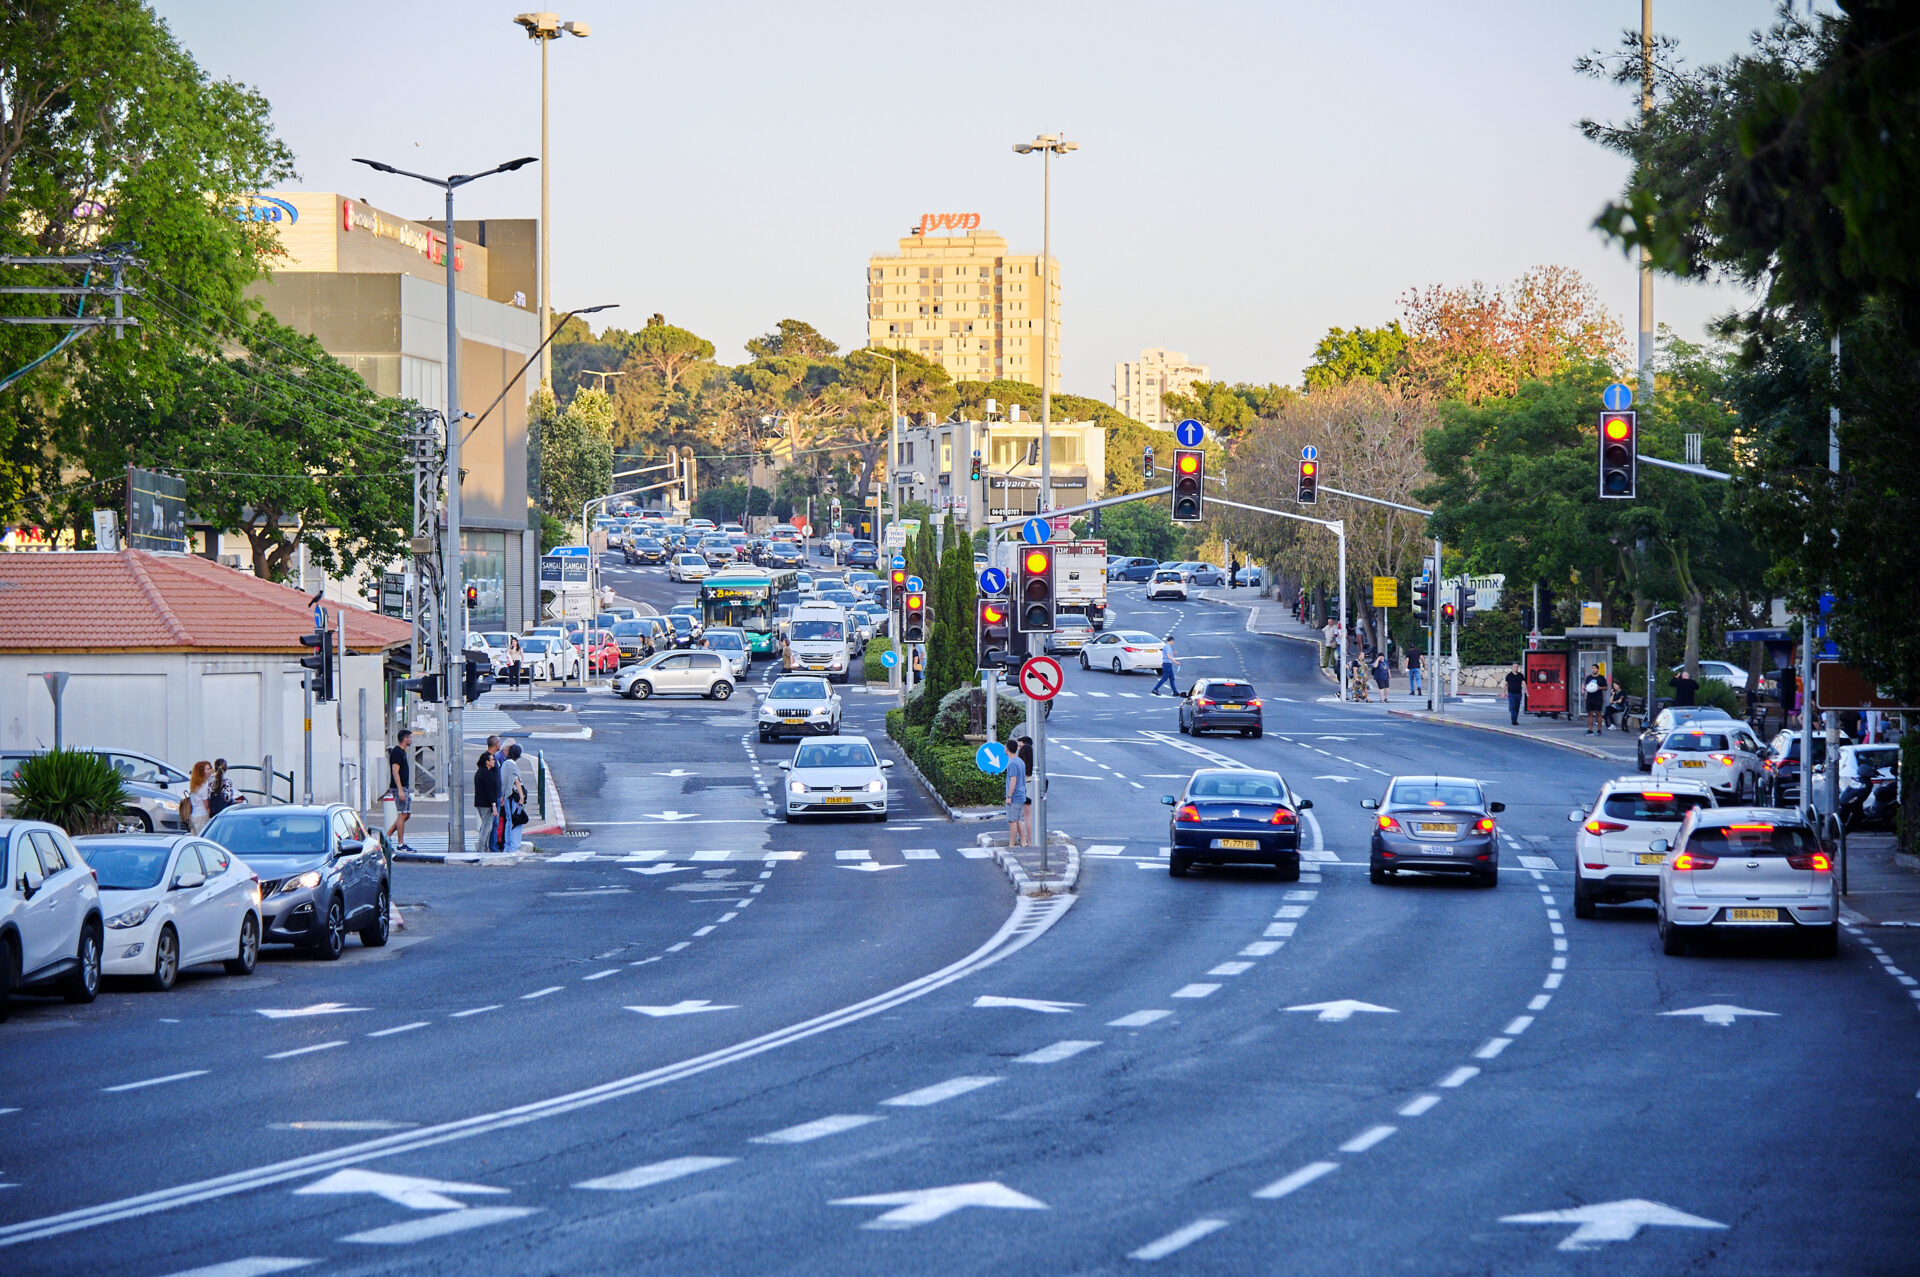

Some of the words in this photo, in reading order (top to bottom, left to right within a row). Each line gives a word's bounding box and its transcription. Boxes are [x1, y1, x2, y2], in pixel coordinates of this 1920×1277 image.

[918, 212, 981, 237] משען
[995, 480, 1026, 488] STUDIO
[1056, 546, 1069, 554] אנג
[1082, 546, 1095, 554] לחם
[542, 561, 562, 570] SAMGAL
[564, 562, 587, 570] SAMGAL
[1469, 579, 1499, 589] אחוזת
